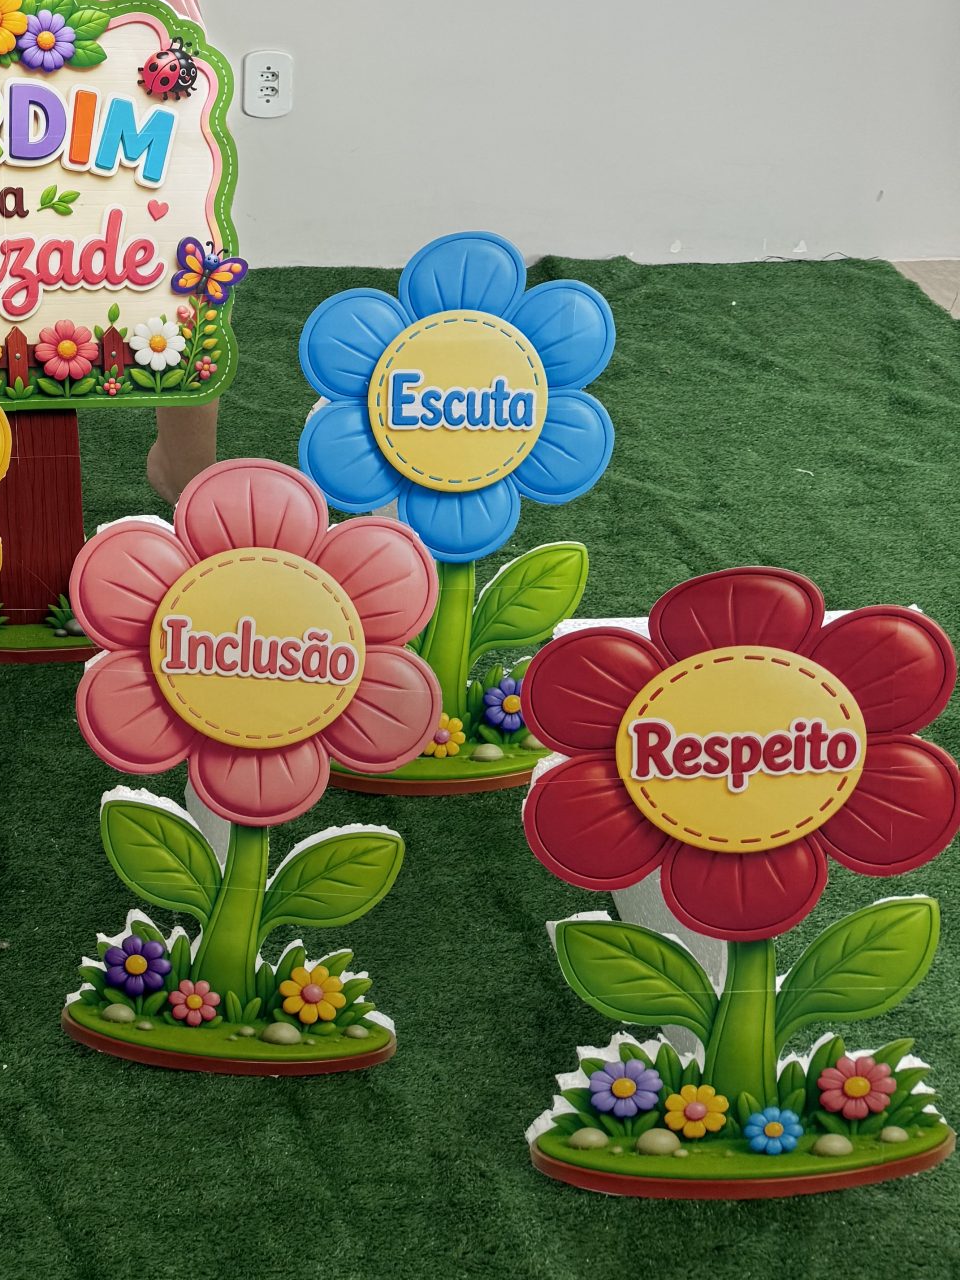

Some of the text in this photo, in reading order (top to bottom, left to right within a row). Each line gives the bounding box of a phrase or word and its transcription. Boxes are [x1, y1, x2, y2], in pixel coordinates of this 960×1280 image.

[392, 372, 534, 427] Escuta
[165, 618, 356, 681] Inclusão
[633, 721, 858, 789] Respeito
